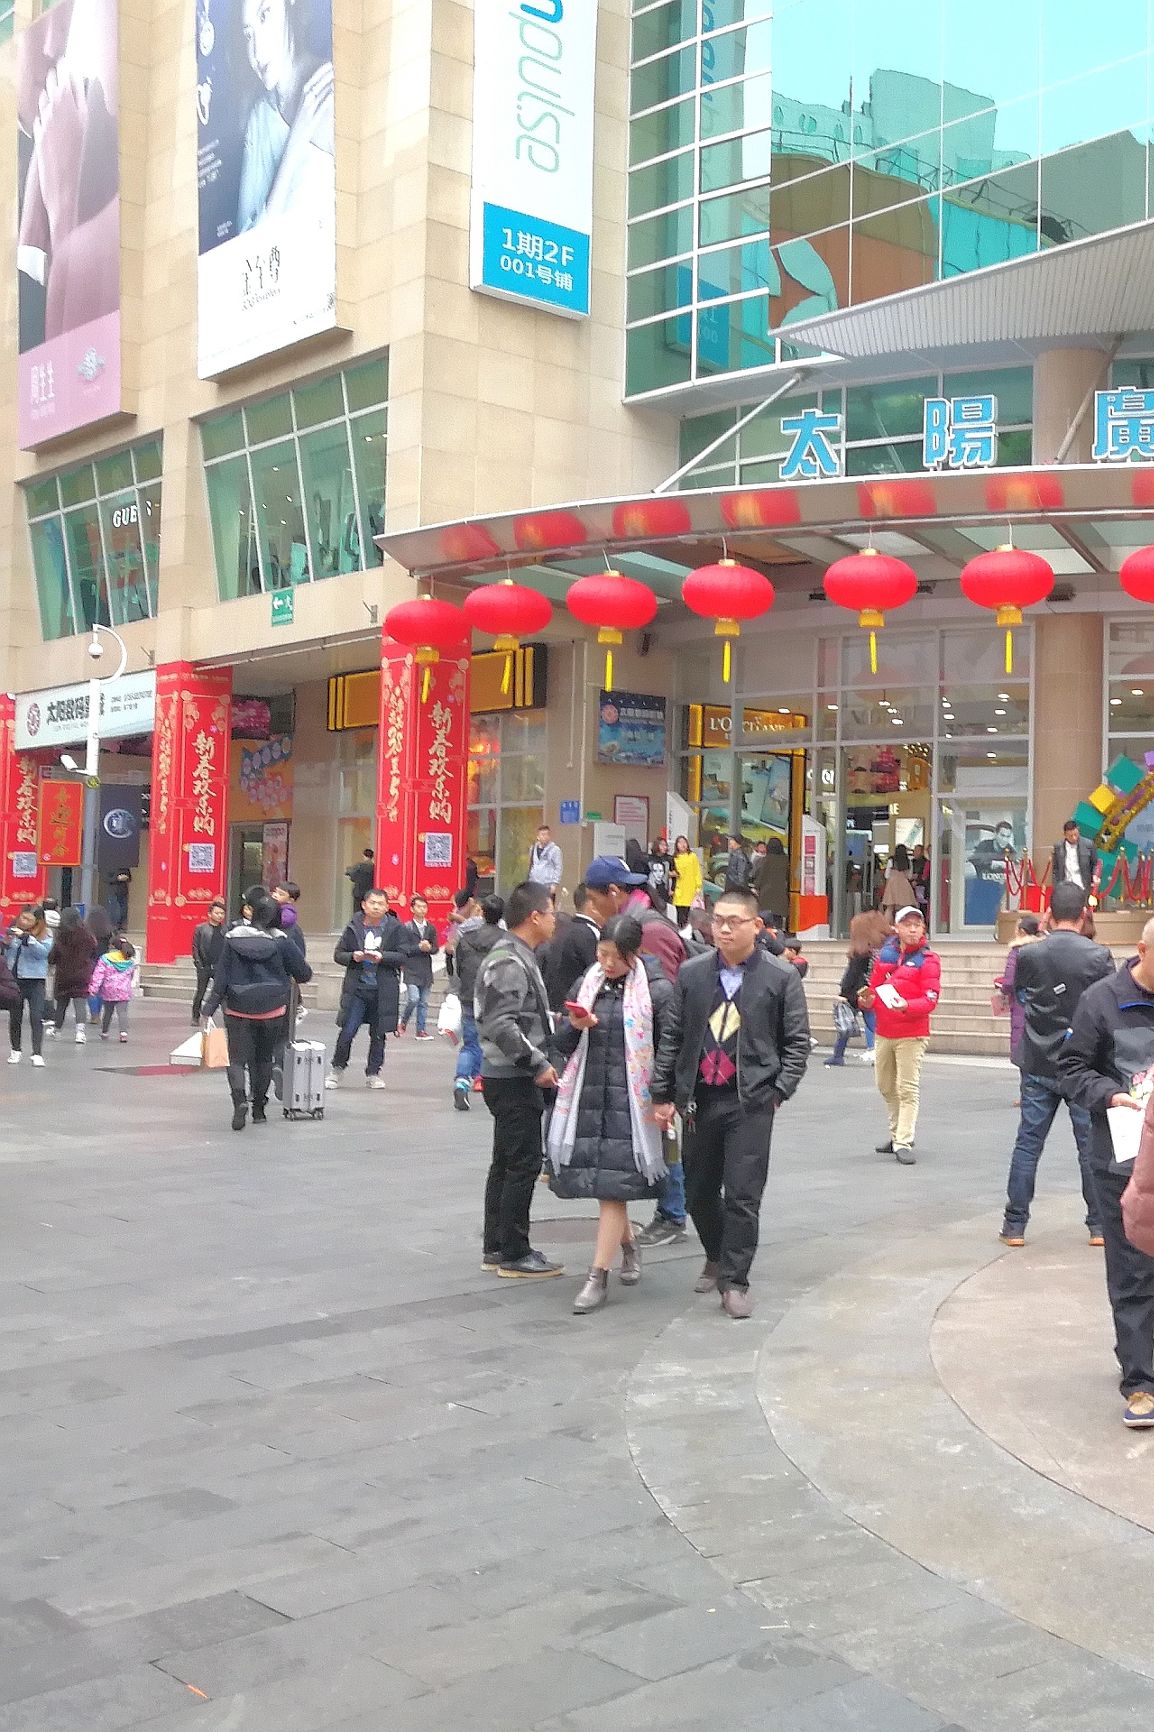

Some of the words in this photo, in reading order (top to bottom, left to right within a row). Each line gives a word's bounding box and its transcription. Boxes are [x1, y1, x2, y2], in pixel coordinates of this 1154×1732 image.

[500, 255, 574, 292] 001号铺
[502, 227, 575, 266] 1期2F
[192, 729, 217, 836] 新春欢乐购
[427, 700, 454, 824] 新春欢乐购
